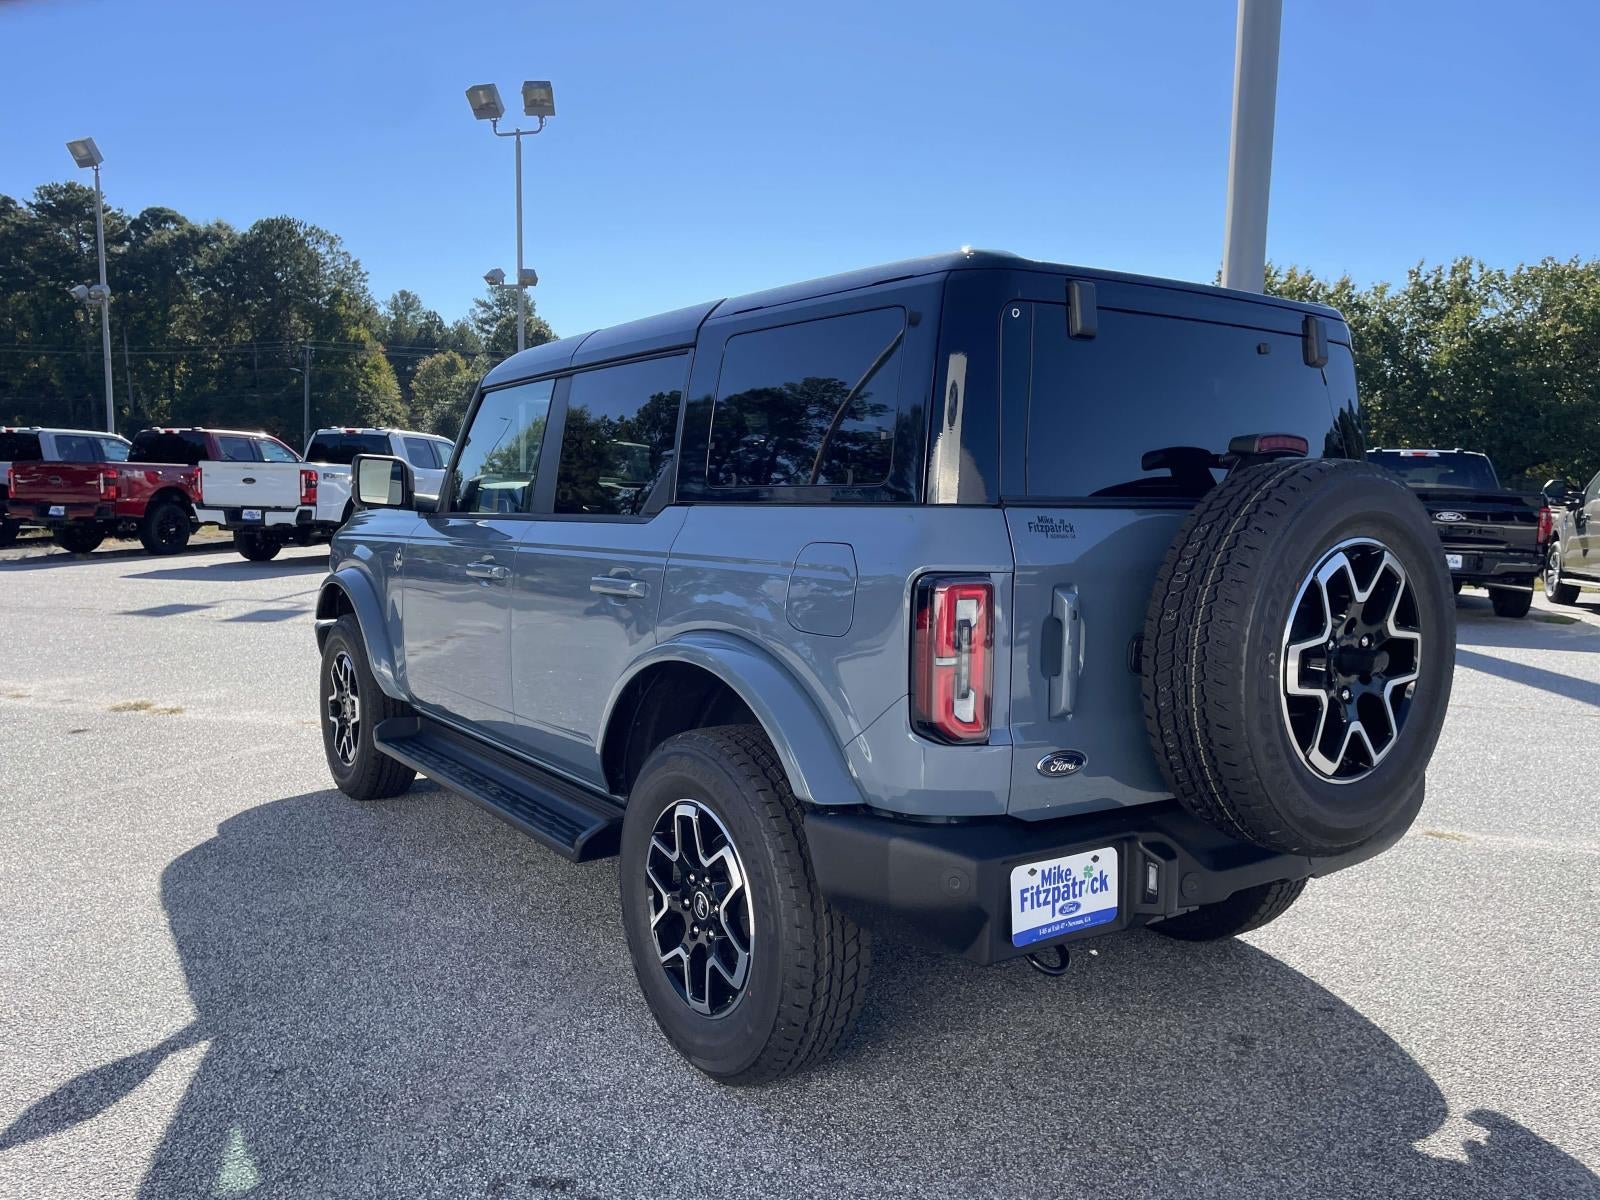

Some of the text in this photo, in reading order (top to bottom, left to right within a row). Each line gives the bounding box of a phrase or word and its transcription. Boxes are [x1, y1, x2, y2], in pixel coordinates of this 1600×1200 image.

[1037, 515, 1054, 524] Mike
[1028, 519, 1075, 538] Fitzpatrick
[1050, 757, 1078, 772] Ford
[1041, 865, 1072, 888] Mike
[1020, 866, 1109, 918] Fitzpatrick
[1061, 903, 1079, 915] Ford
